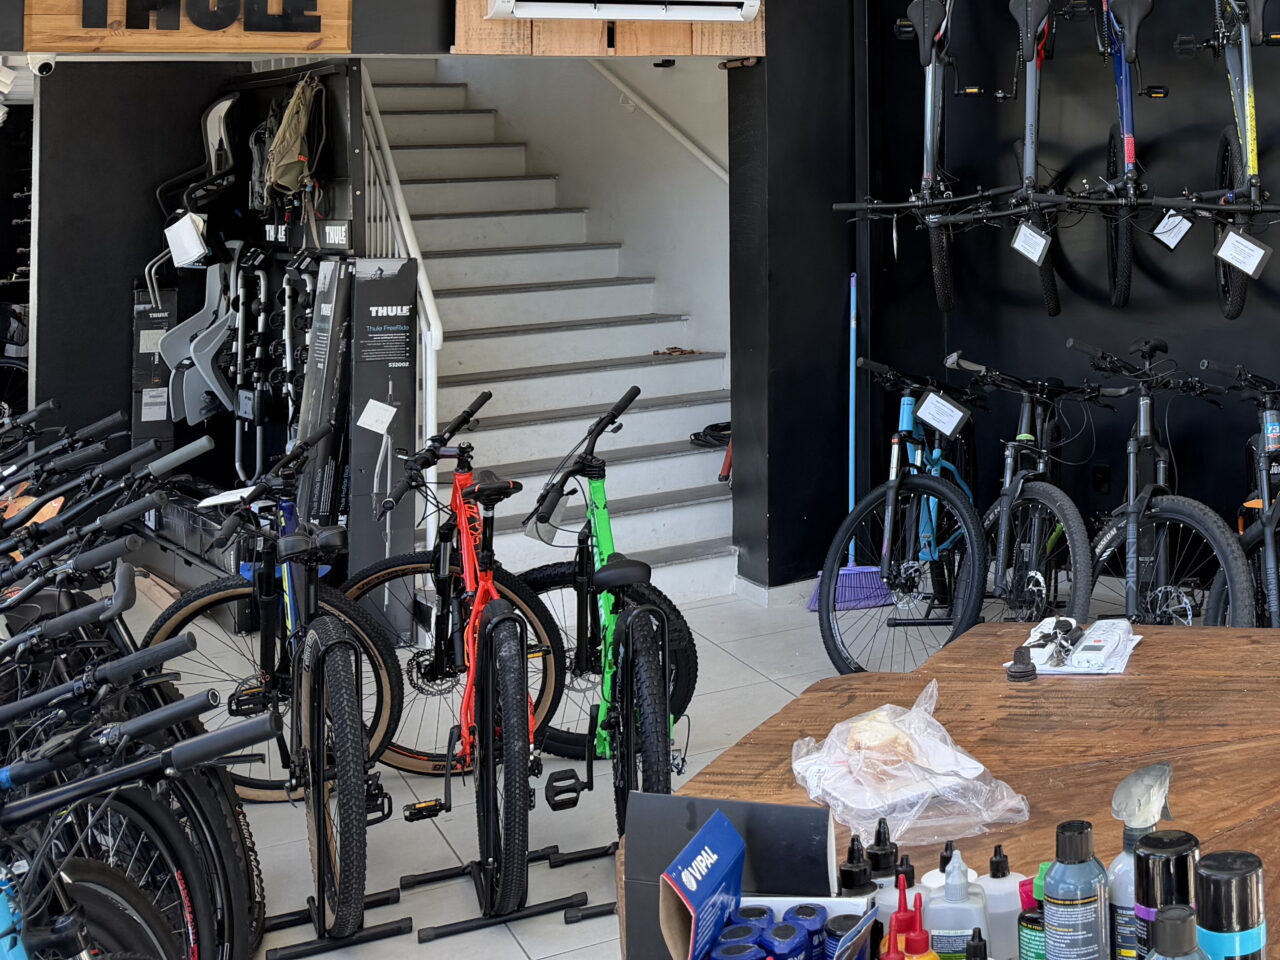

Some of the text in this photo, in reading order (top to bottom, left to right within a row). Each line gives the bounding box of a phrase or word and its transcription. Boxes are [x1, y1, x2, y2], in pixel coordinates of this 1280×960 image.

[265, 224, 286, 242] THLE
[325, 225, 347, 244] THULE
[370, 306, 410, 317] THULE
[984, 507, 1001, 528] KEN
[690, 846, 718, 882] VIPAL
[247, 851, 262, 902] MAZZA
